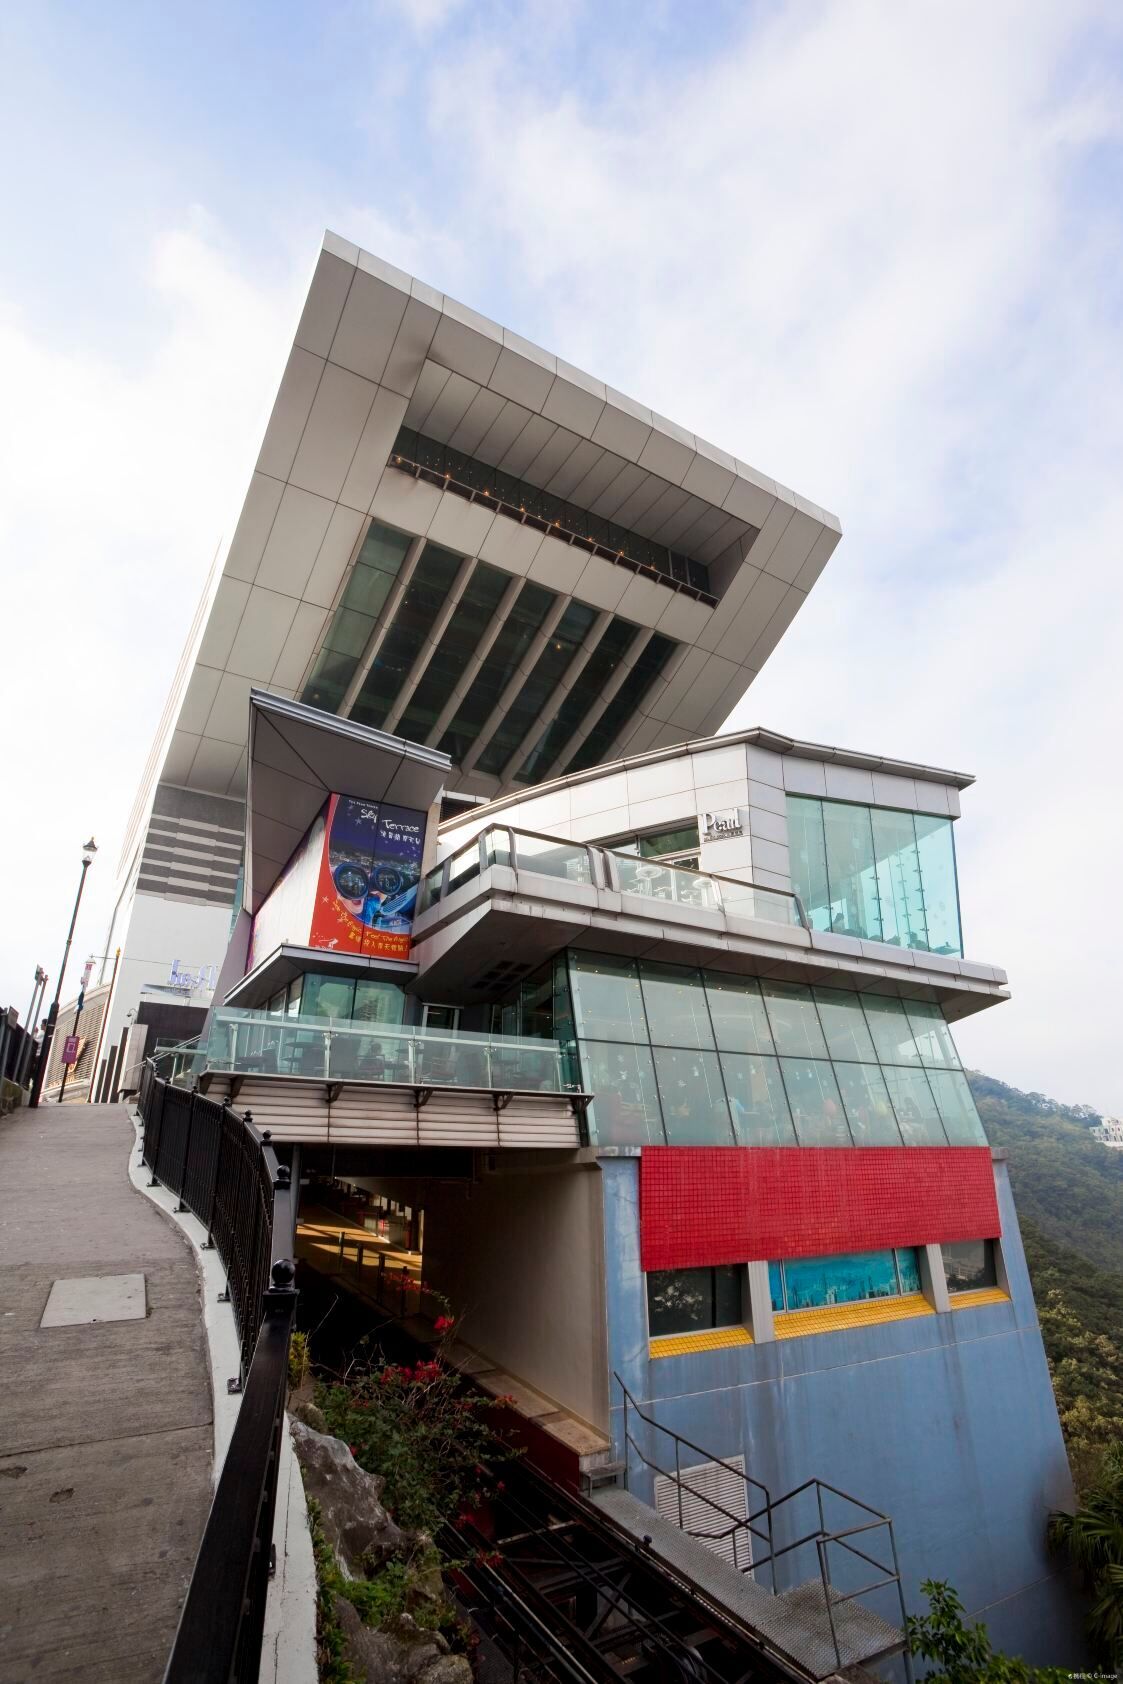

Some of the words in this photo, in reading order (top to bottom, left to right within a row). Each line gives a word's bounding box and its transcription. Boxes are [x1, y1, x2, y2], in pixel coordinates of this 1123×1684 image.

[361, 809, 377, 823] Sky
[383, 820, 419, 832] Terrace
[702, 807, 741, 833] Pearl
